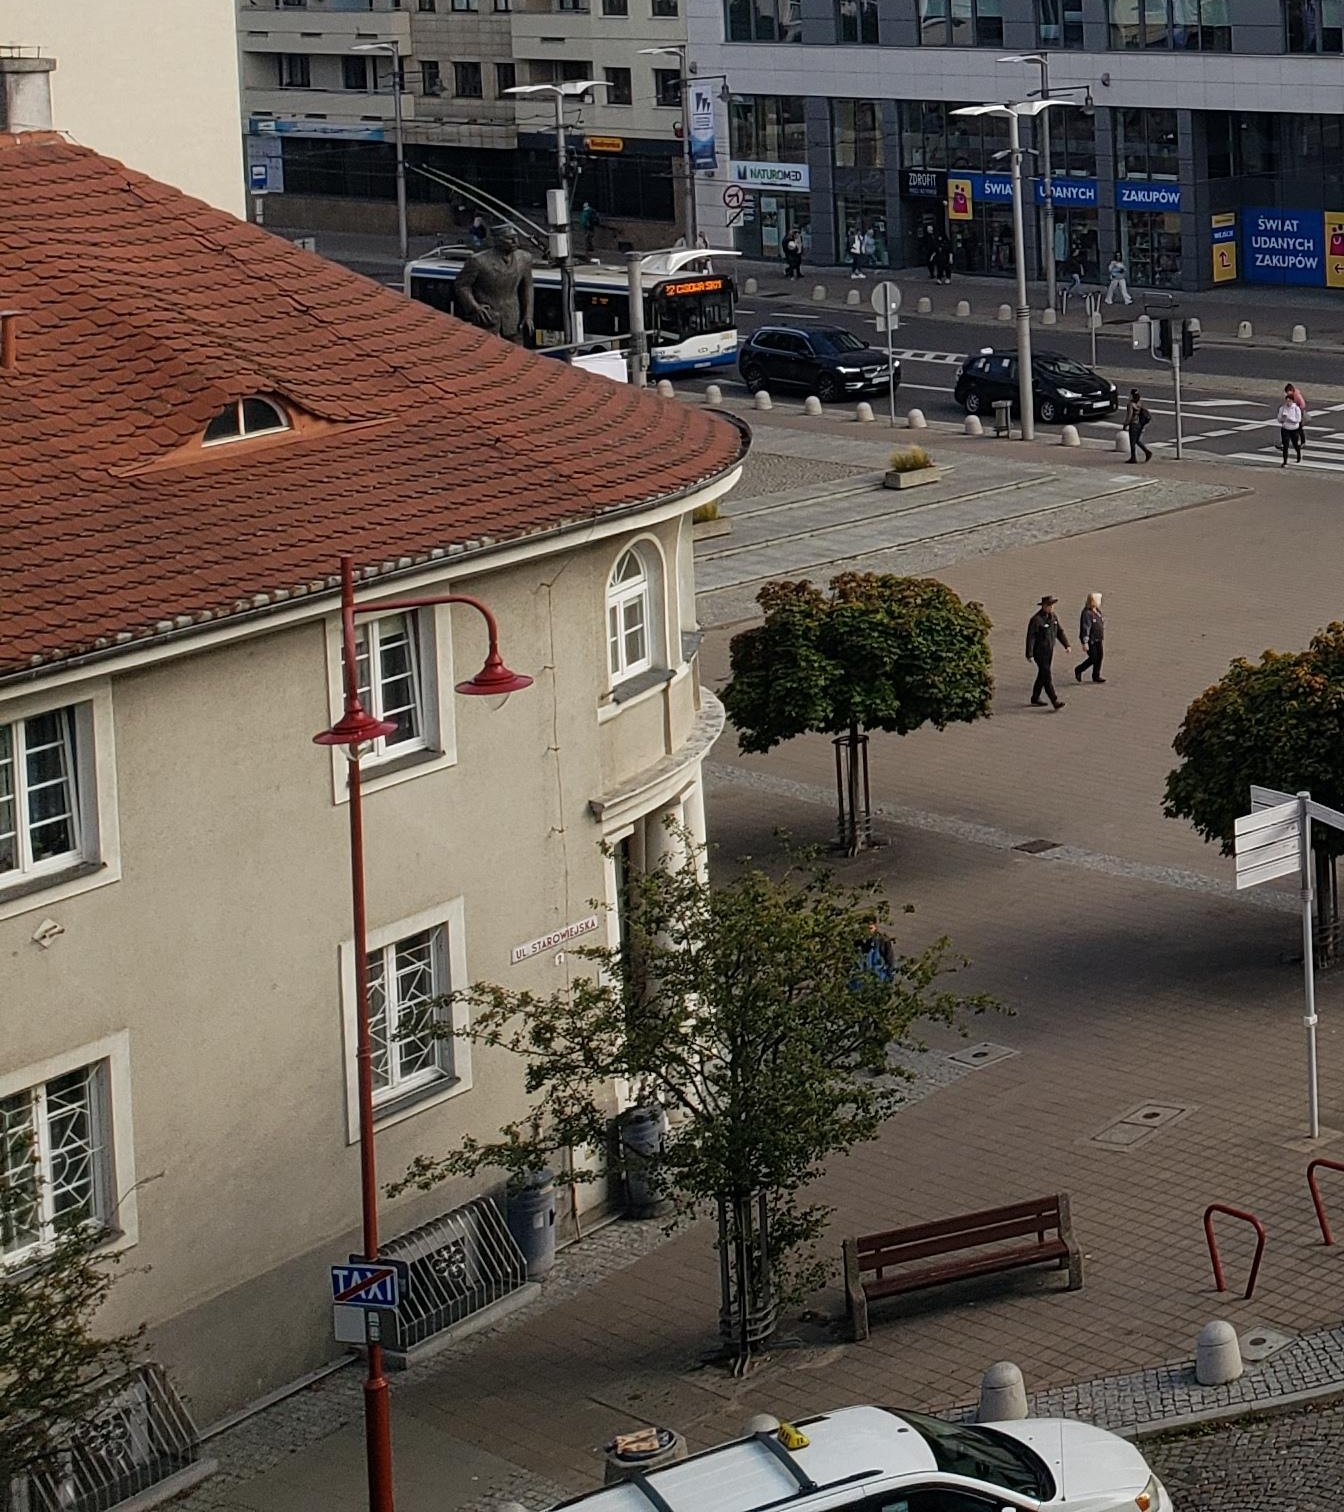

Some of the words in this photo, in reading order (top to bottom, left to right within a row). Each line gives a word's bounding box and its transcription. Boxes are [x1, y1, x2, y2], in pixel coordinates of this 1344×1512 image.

[750, 169, 802, 182] NATUROMED
[908, 172, 937, 186] ZDROFIT
[984, 179, 1013, 195] ŚWIA
[1122, 187, 1181, 204] ZAKUPÓW
[1258, 215, 1300, 232] ŚWIAT
[1252, 236, 1314, 251] UDANYCH
[1255, 253, 1318, 269] ZAKUPÓW
[531, 919, 596, 953] STAROWIEJSKA
[332, 1269, 392, 1301] TAXI
